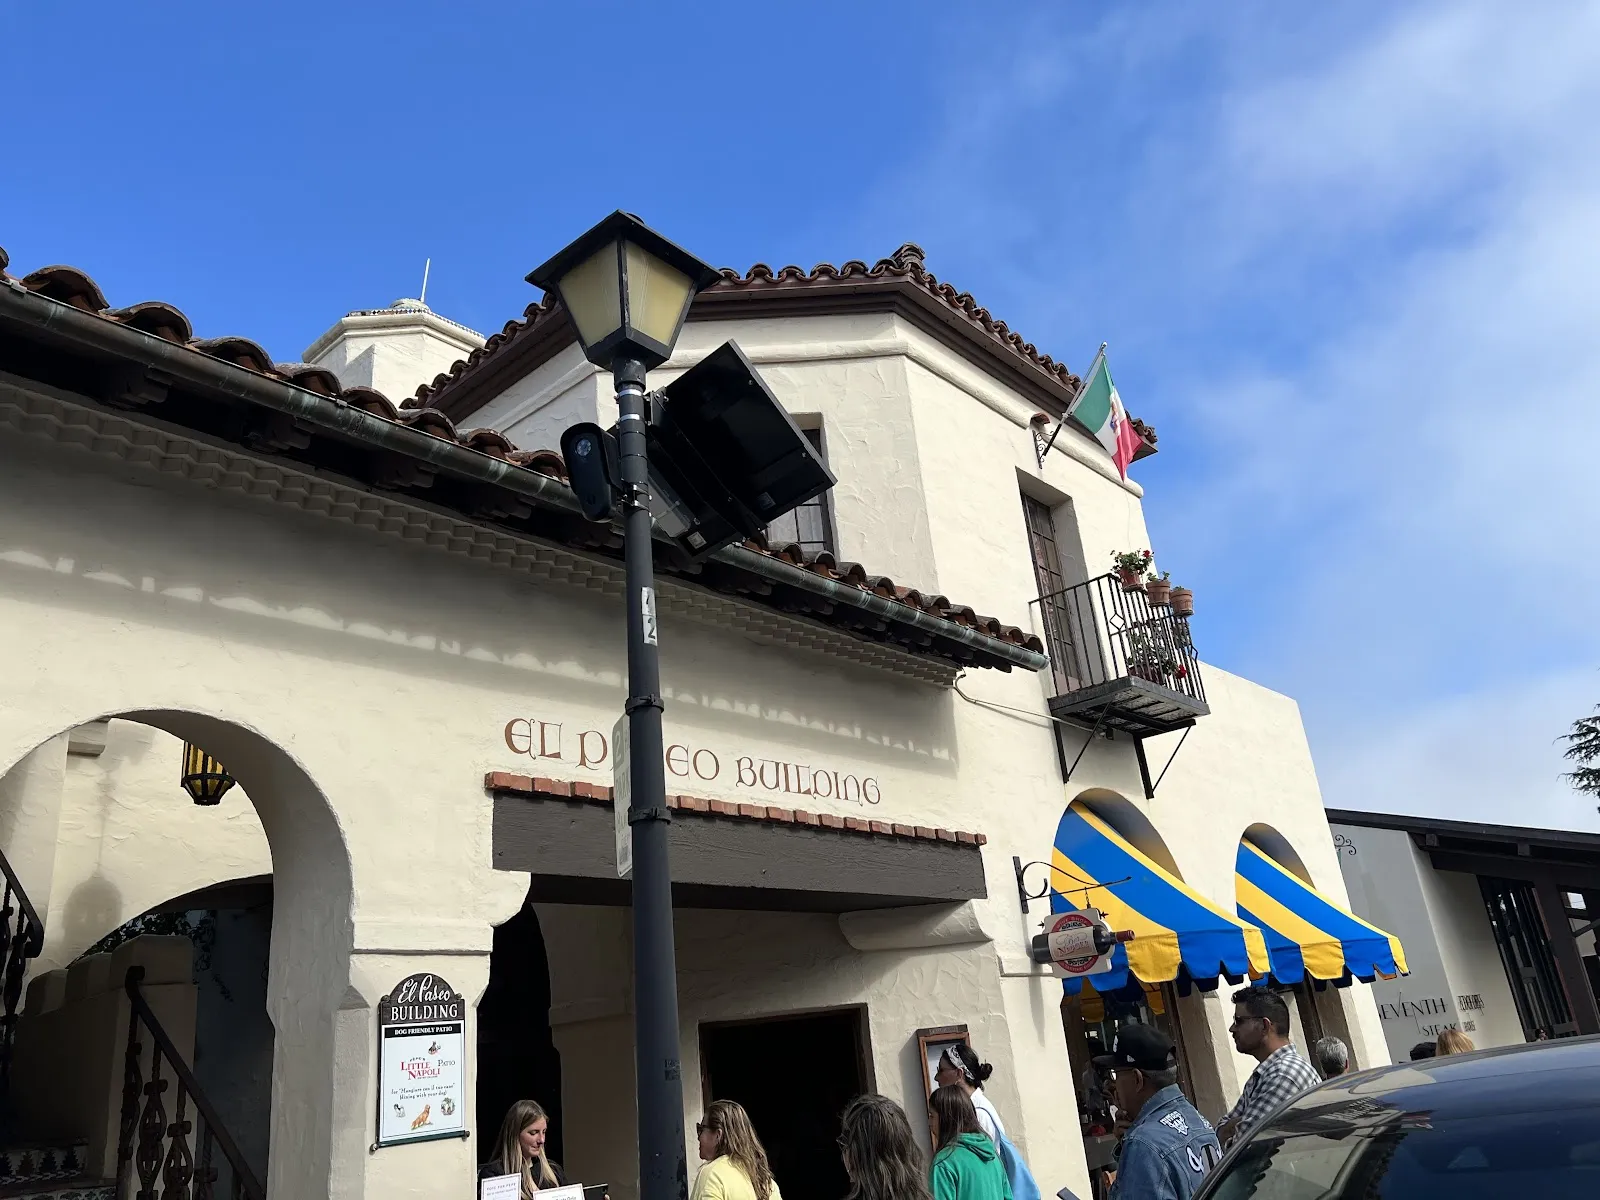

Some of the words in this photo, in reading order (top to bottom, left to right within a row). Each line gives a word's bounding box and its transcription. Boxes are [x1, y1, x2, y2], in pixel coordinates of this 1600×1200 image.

[503, 717, 564, 760] EL
[576, 729, 720, 782] PEO
[736, 756, 882, 806] BUILDING
[397, 979, 418, 1004] El
[418, 974, 451, 1004] Paseo
[391, 1003, 458, 1021] BUILDING
[1379, 992, 1448, 1022] EVENTH
[408, 1026, 435, 1035] FRIENDLY
[435, 1025, 453, 1033] PATIO
